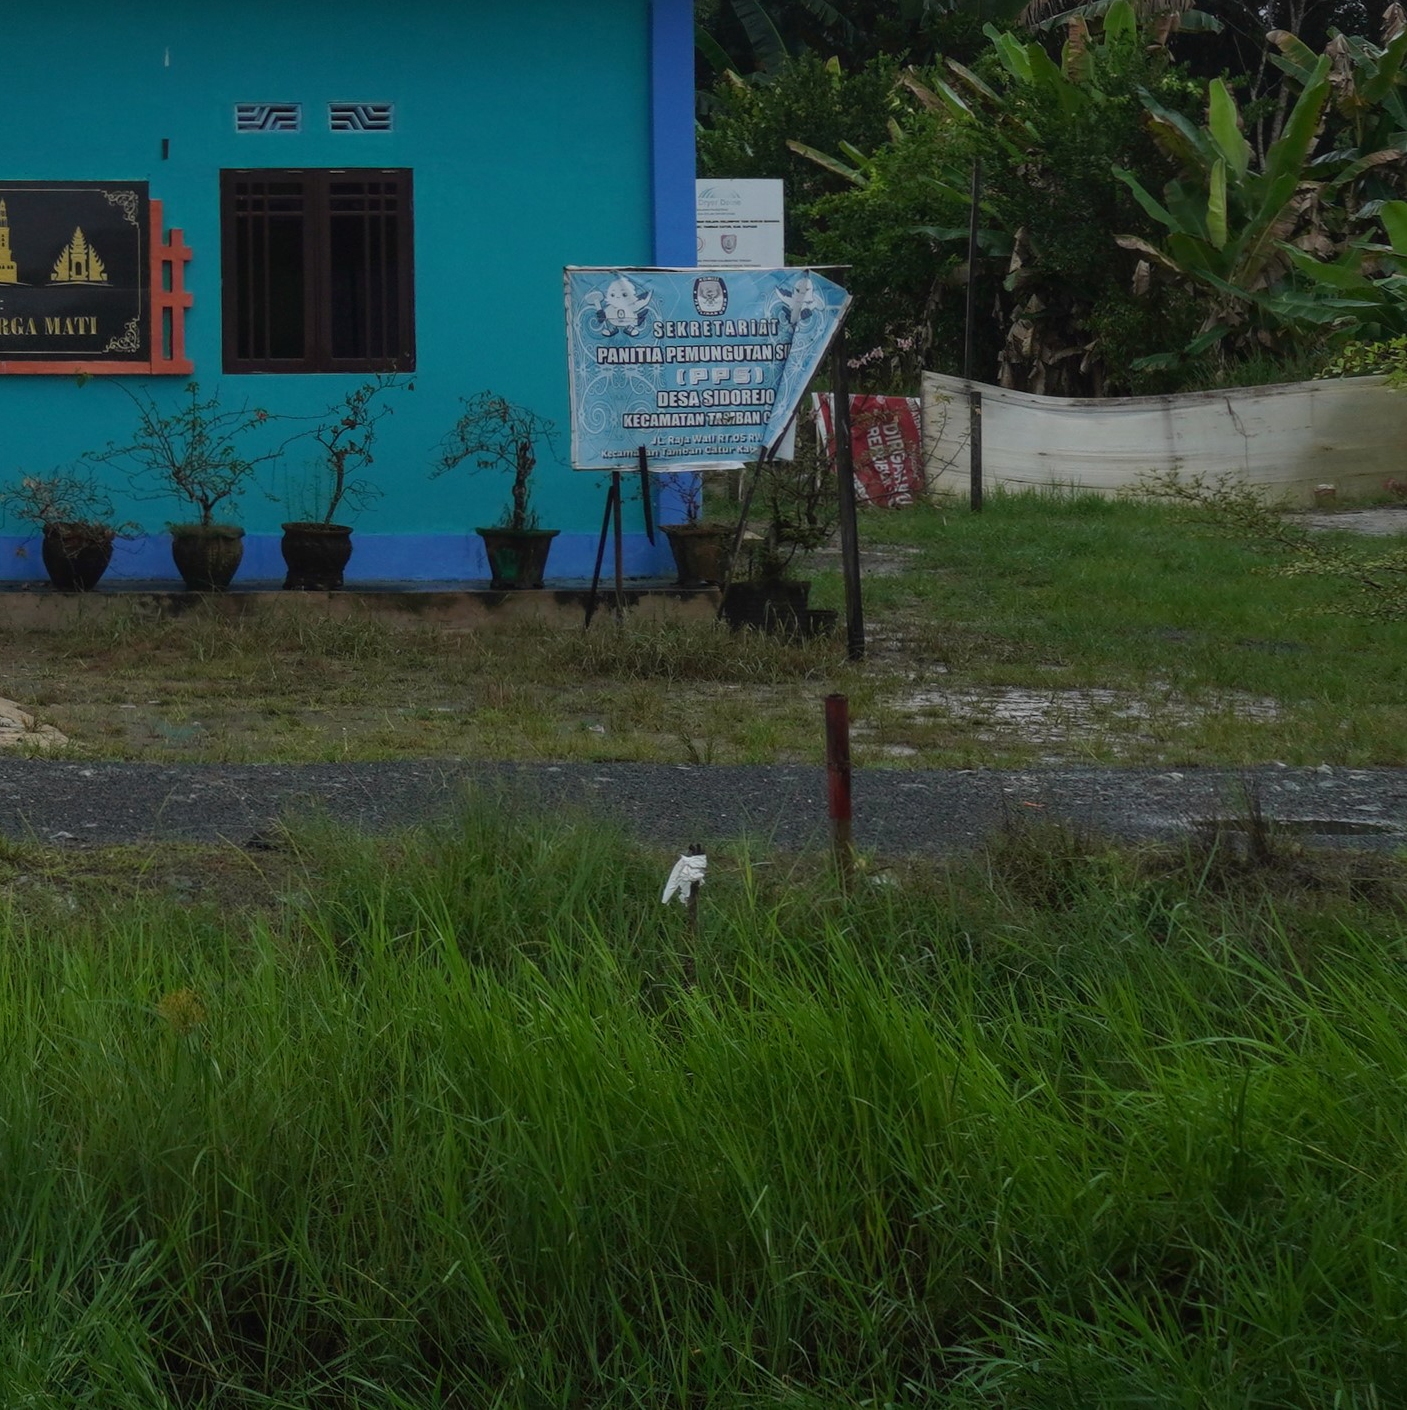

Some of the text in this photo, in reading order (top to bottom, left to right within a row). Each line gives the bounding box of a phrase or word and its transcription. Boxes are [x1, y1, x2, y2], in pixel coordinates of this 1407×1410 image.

[44, 317, 98, 336] MATI
[597, 345, 664, 364] PANITIA
[665, 343, 774, 363] PEMUNGUTAN
[656, 388, 776, 408] DESA SIDOREJO
[622, 411, 705, 428] KECAMATAN
[601, 447, 660, 459] Kecamaan
